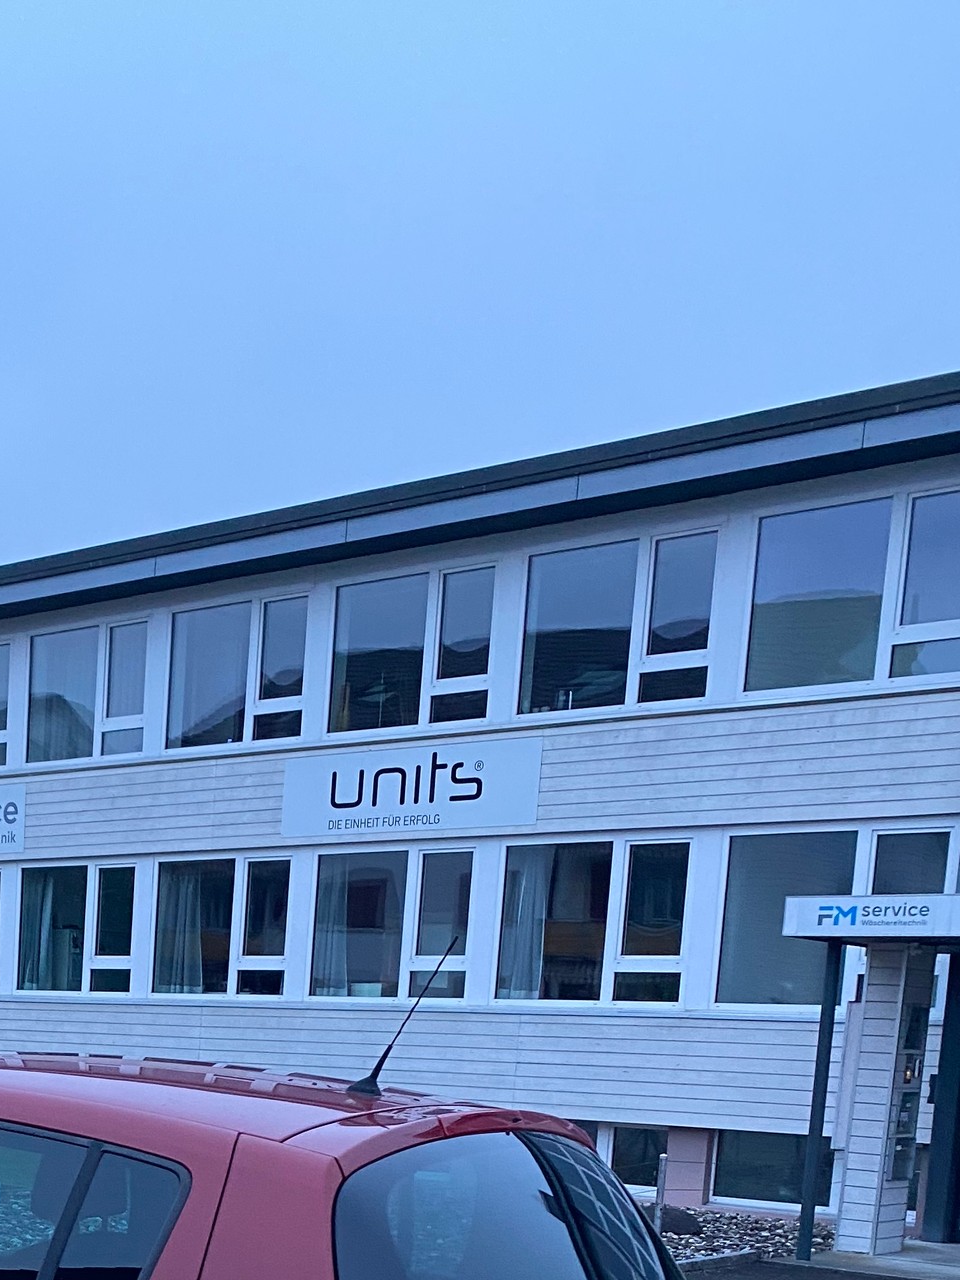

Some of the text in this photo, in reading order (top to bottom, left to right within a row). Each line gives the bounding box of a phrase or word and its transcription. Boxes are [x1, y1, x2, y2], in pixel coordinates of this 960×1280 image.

[328, 814, 441, 830] DIE EINHEIT FÜR ERFOLG
[817, 902, 930, 926] FM service
